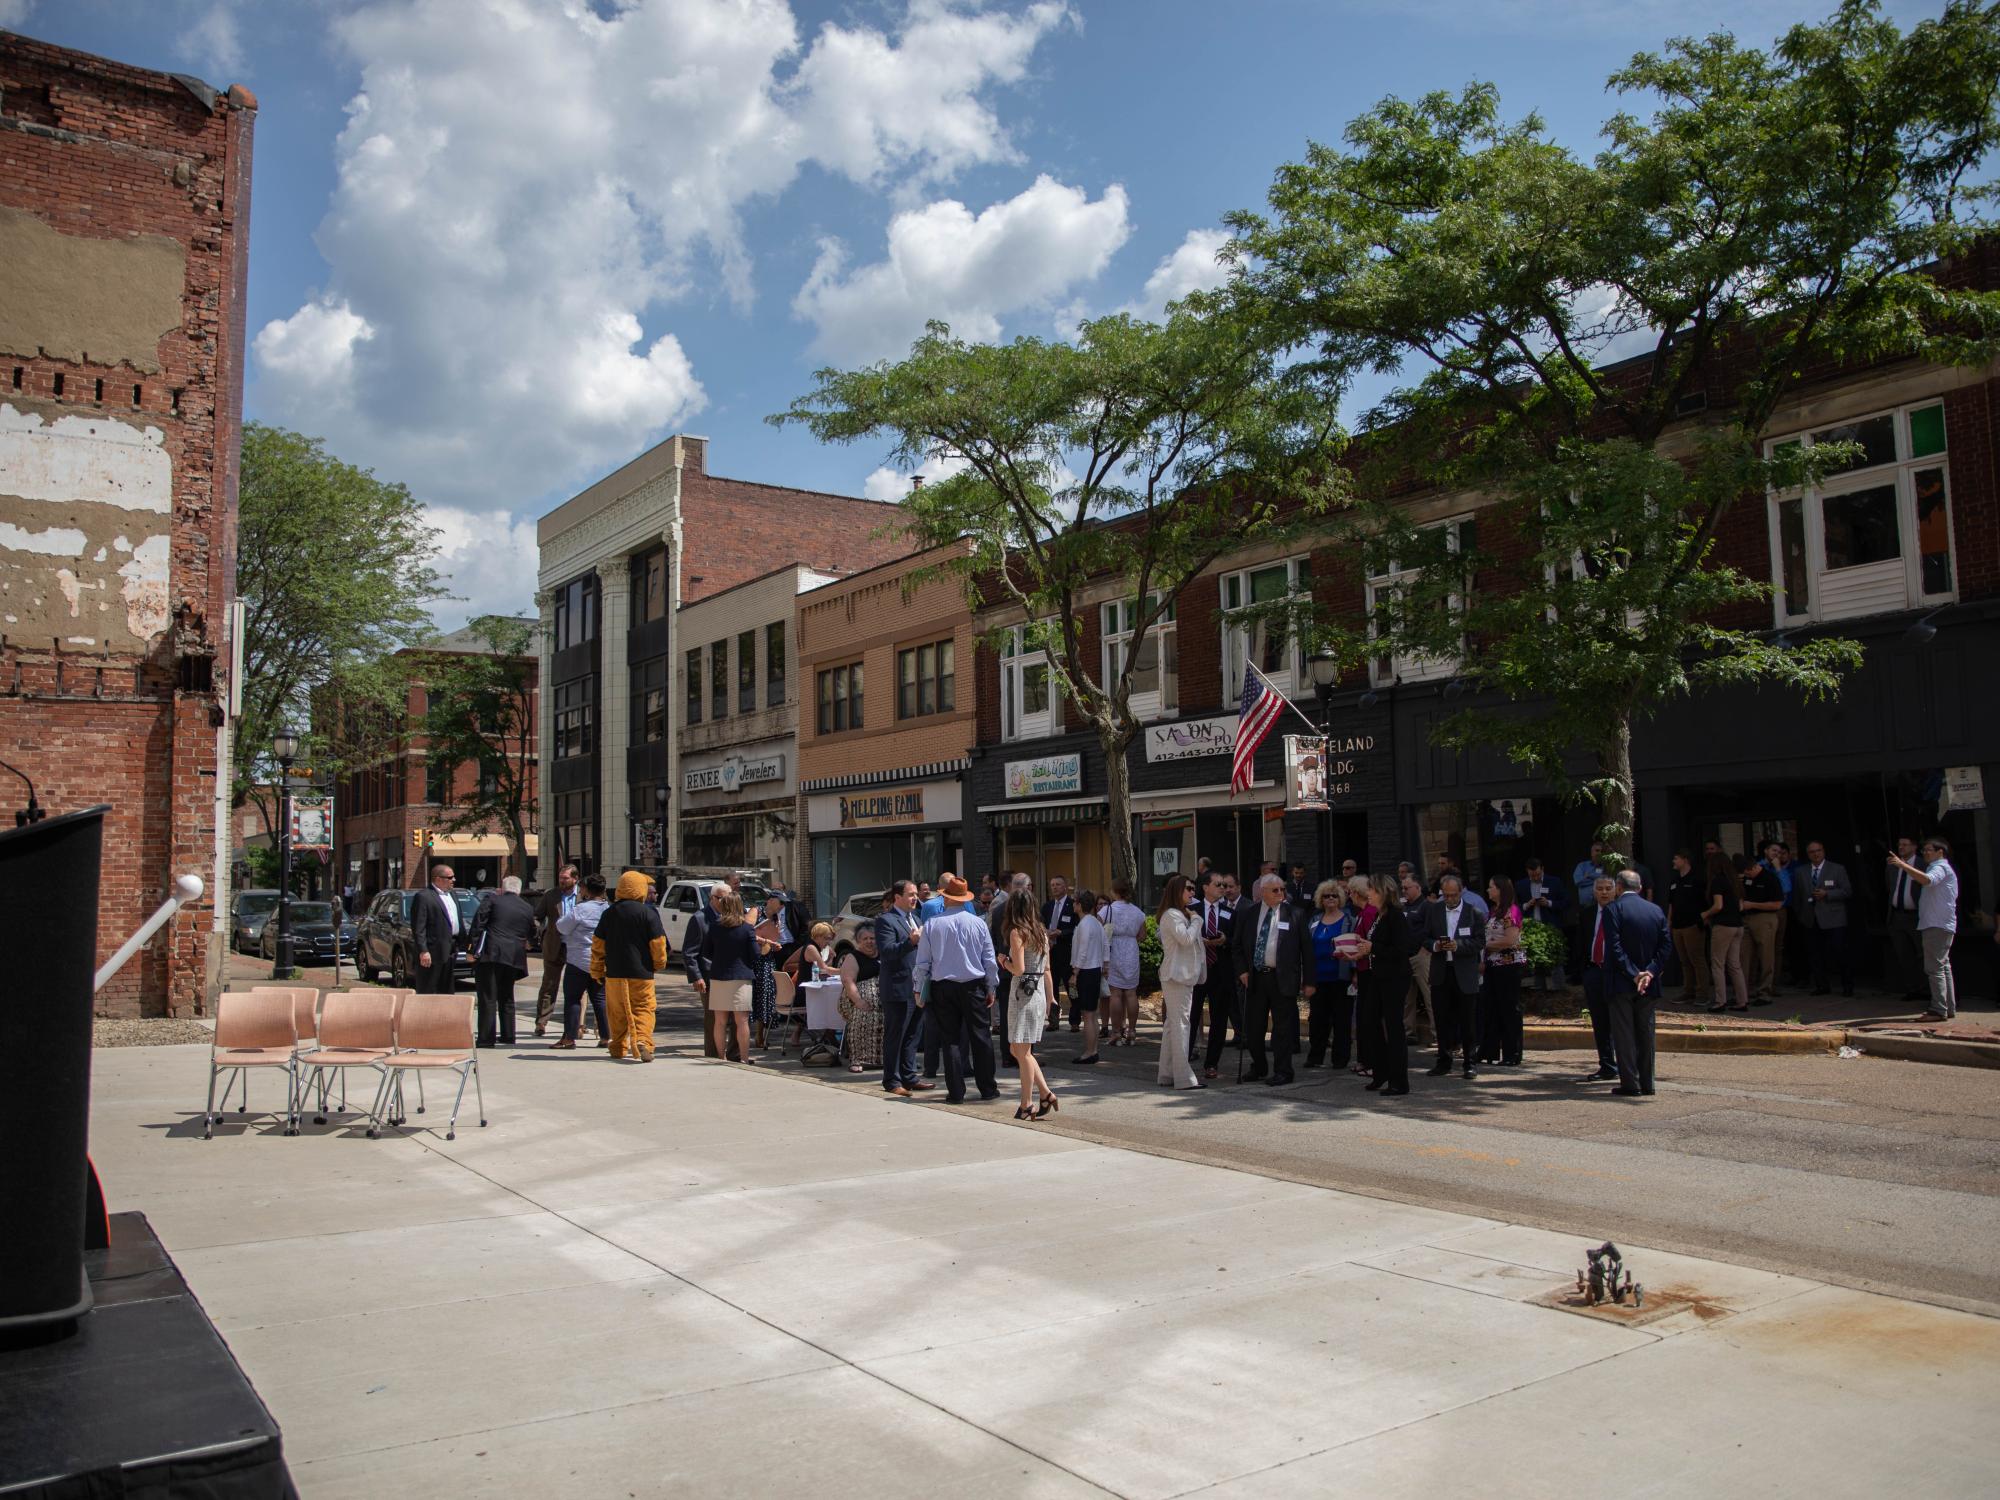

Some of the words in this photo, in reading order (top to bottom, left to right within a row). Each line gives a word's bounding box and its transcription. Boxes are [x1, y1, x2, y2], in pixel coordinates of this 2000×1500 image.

[1155, 744, 1236, 761] 412-443-0737
[1329, 736, 1374, 753] ELAND
[686, 769, 720, 790] RENEE
[740, 762, 776, 781] Jewelers
[1330, 759, 1357, 776] LDG.
[1032, 779, 1078, 793] RESTAURANT
[850, 795, 894, 818] HELPING
